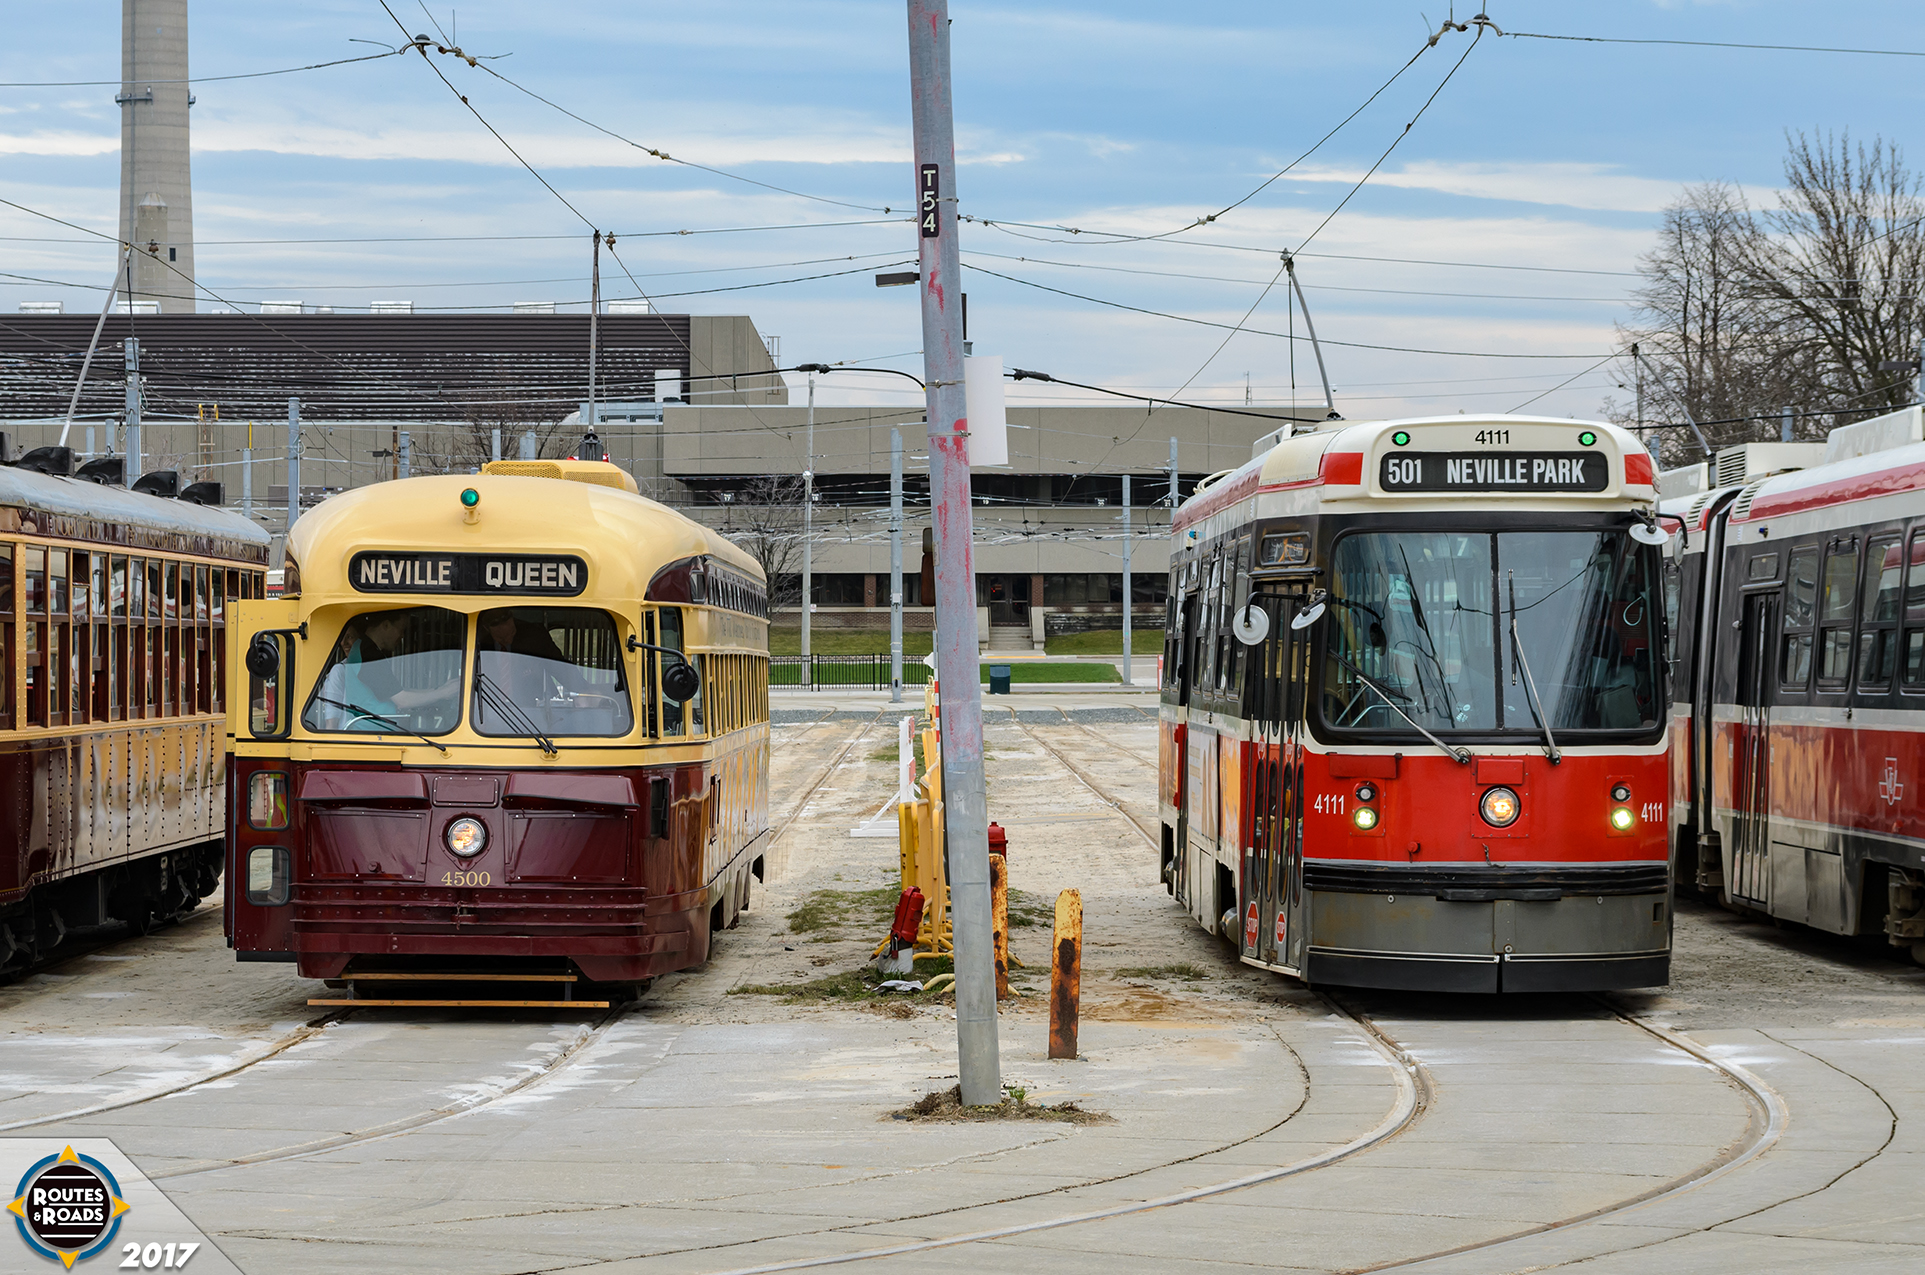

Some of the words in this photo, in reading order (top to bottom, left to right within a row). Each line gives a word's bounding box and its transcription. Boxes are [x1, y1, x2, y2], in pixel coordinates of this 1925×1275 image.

[922, 169, 937, 233] T54
[1474, 429, 1511, 446] 4111
[1387, 458, 1423, 485] 501
[1446, 458, 1528, 485] NEVILLE
[1532, 458, 1586, 485] PARK
[360, 559, 452, 586] NEVILLE
[485, 561, 578, 588] QUEEN
[1313, 793, 1345, 815] 4111
[1640, 802, 1663, 823] 4111
[440, 871, 491, 887] 4500
